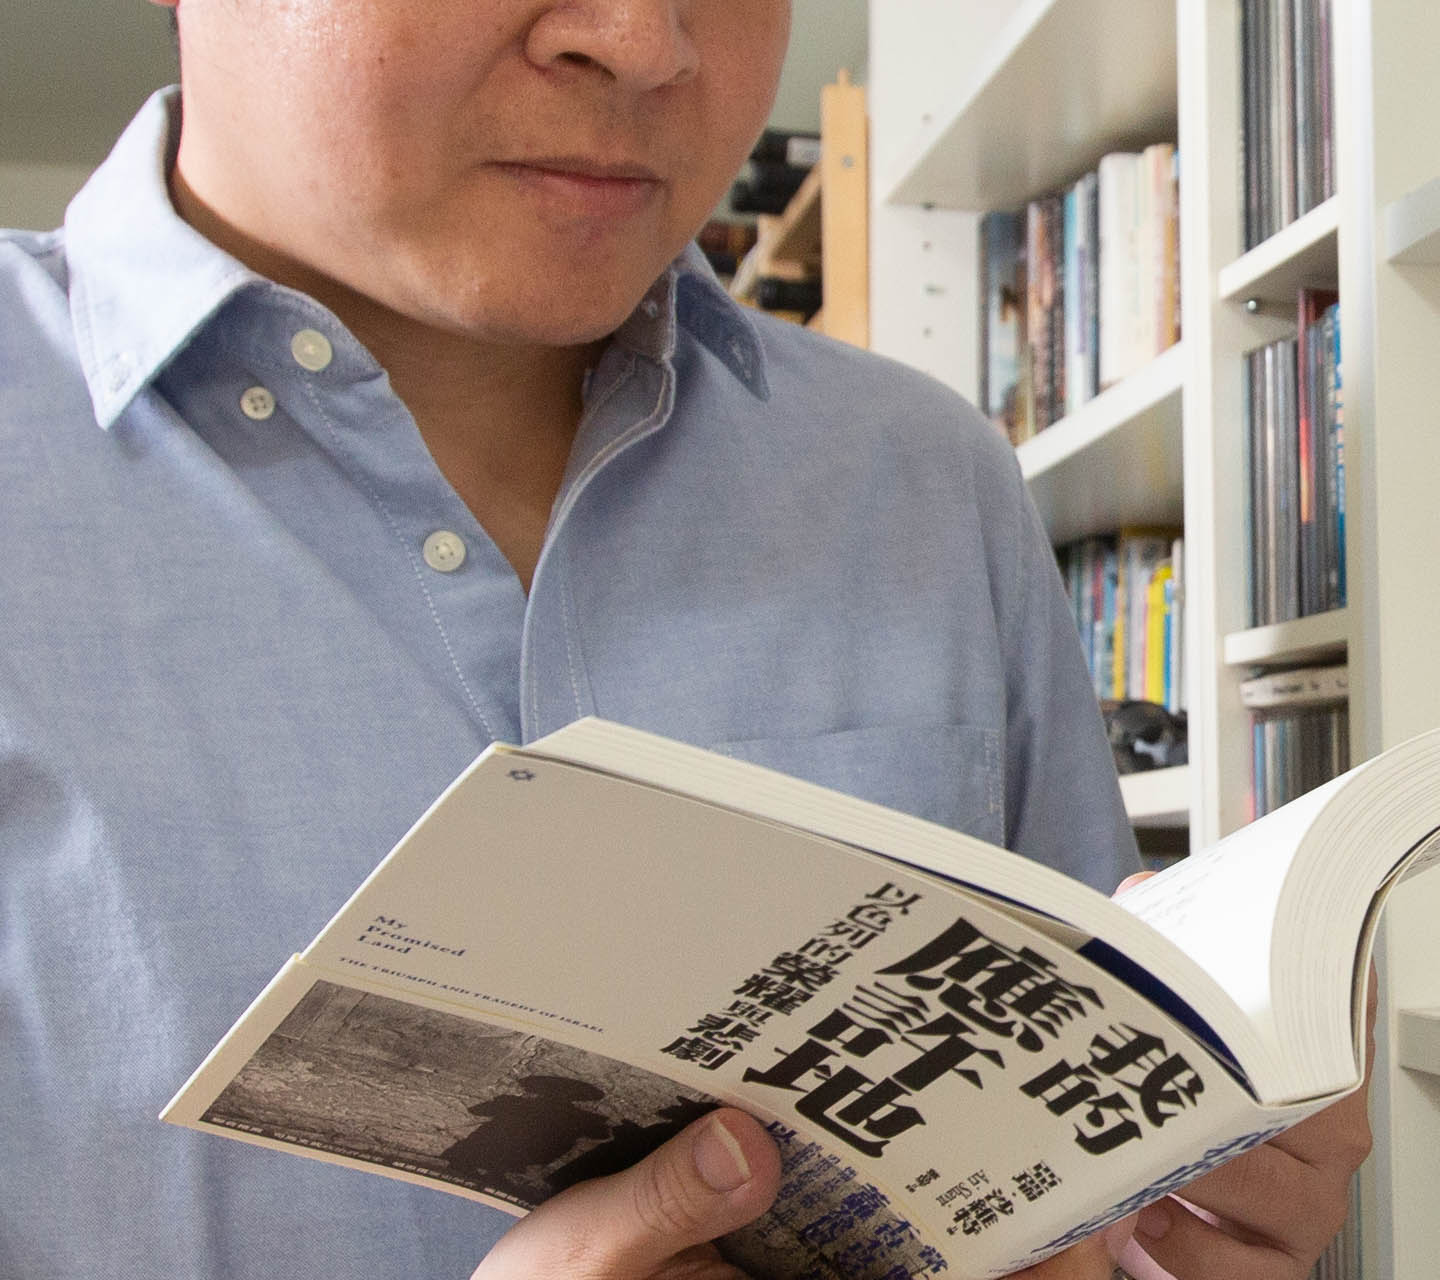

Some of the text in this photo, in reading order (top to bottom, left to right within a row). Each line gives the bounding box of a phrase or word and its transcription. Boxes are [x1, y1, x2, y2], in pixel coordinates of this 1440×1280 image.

[366, 925, 466, 958] Promised
[375, 915, 409, 930] My
[357, 935, 412, 955] Land
[660, 880, 926, 1071] 以色列的榮耀與悲劇
[340, 957, 605, 1034] THE TRIUMPH AND TRAGEDY OF ISRAEL
[1019, 1022, 1206, 1156] 我的
[936, 1169, 991, 1208] Ari Shavit
